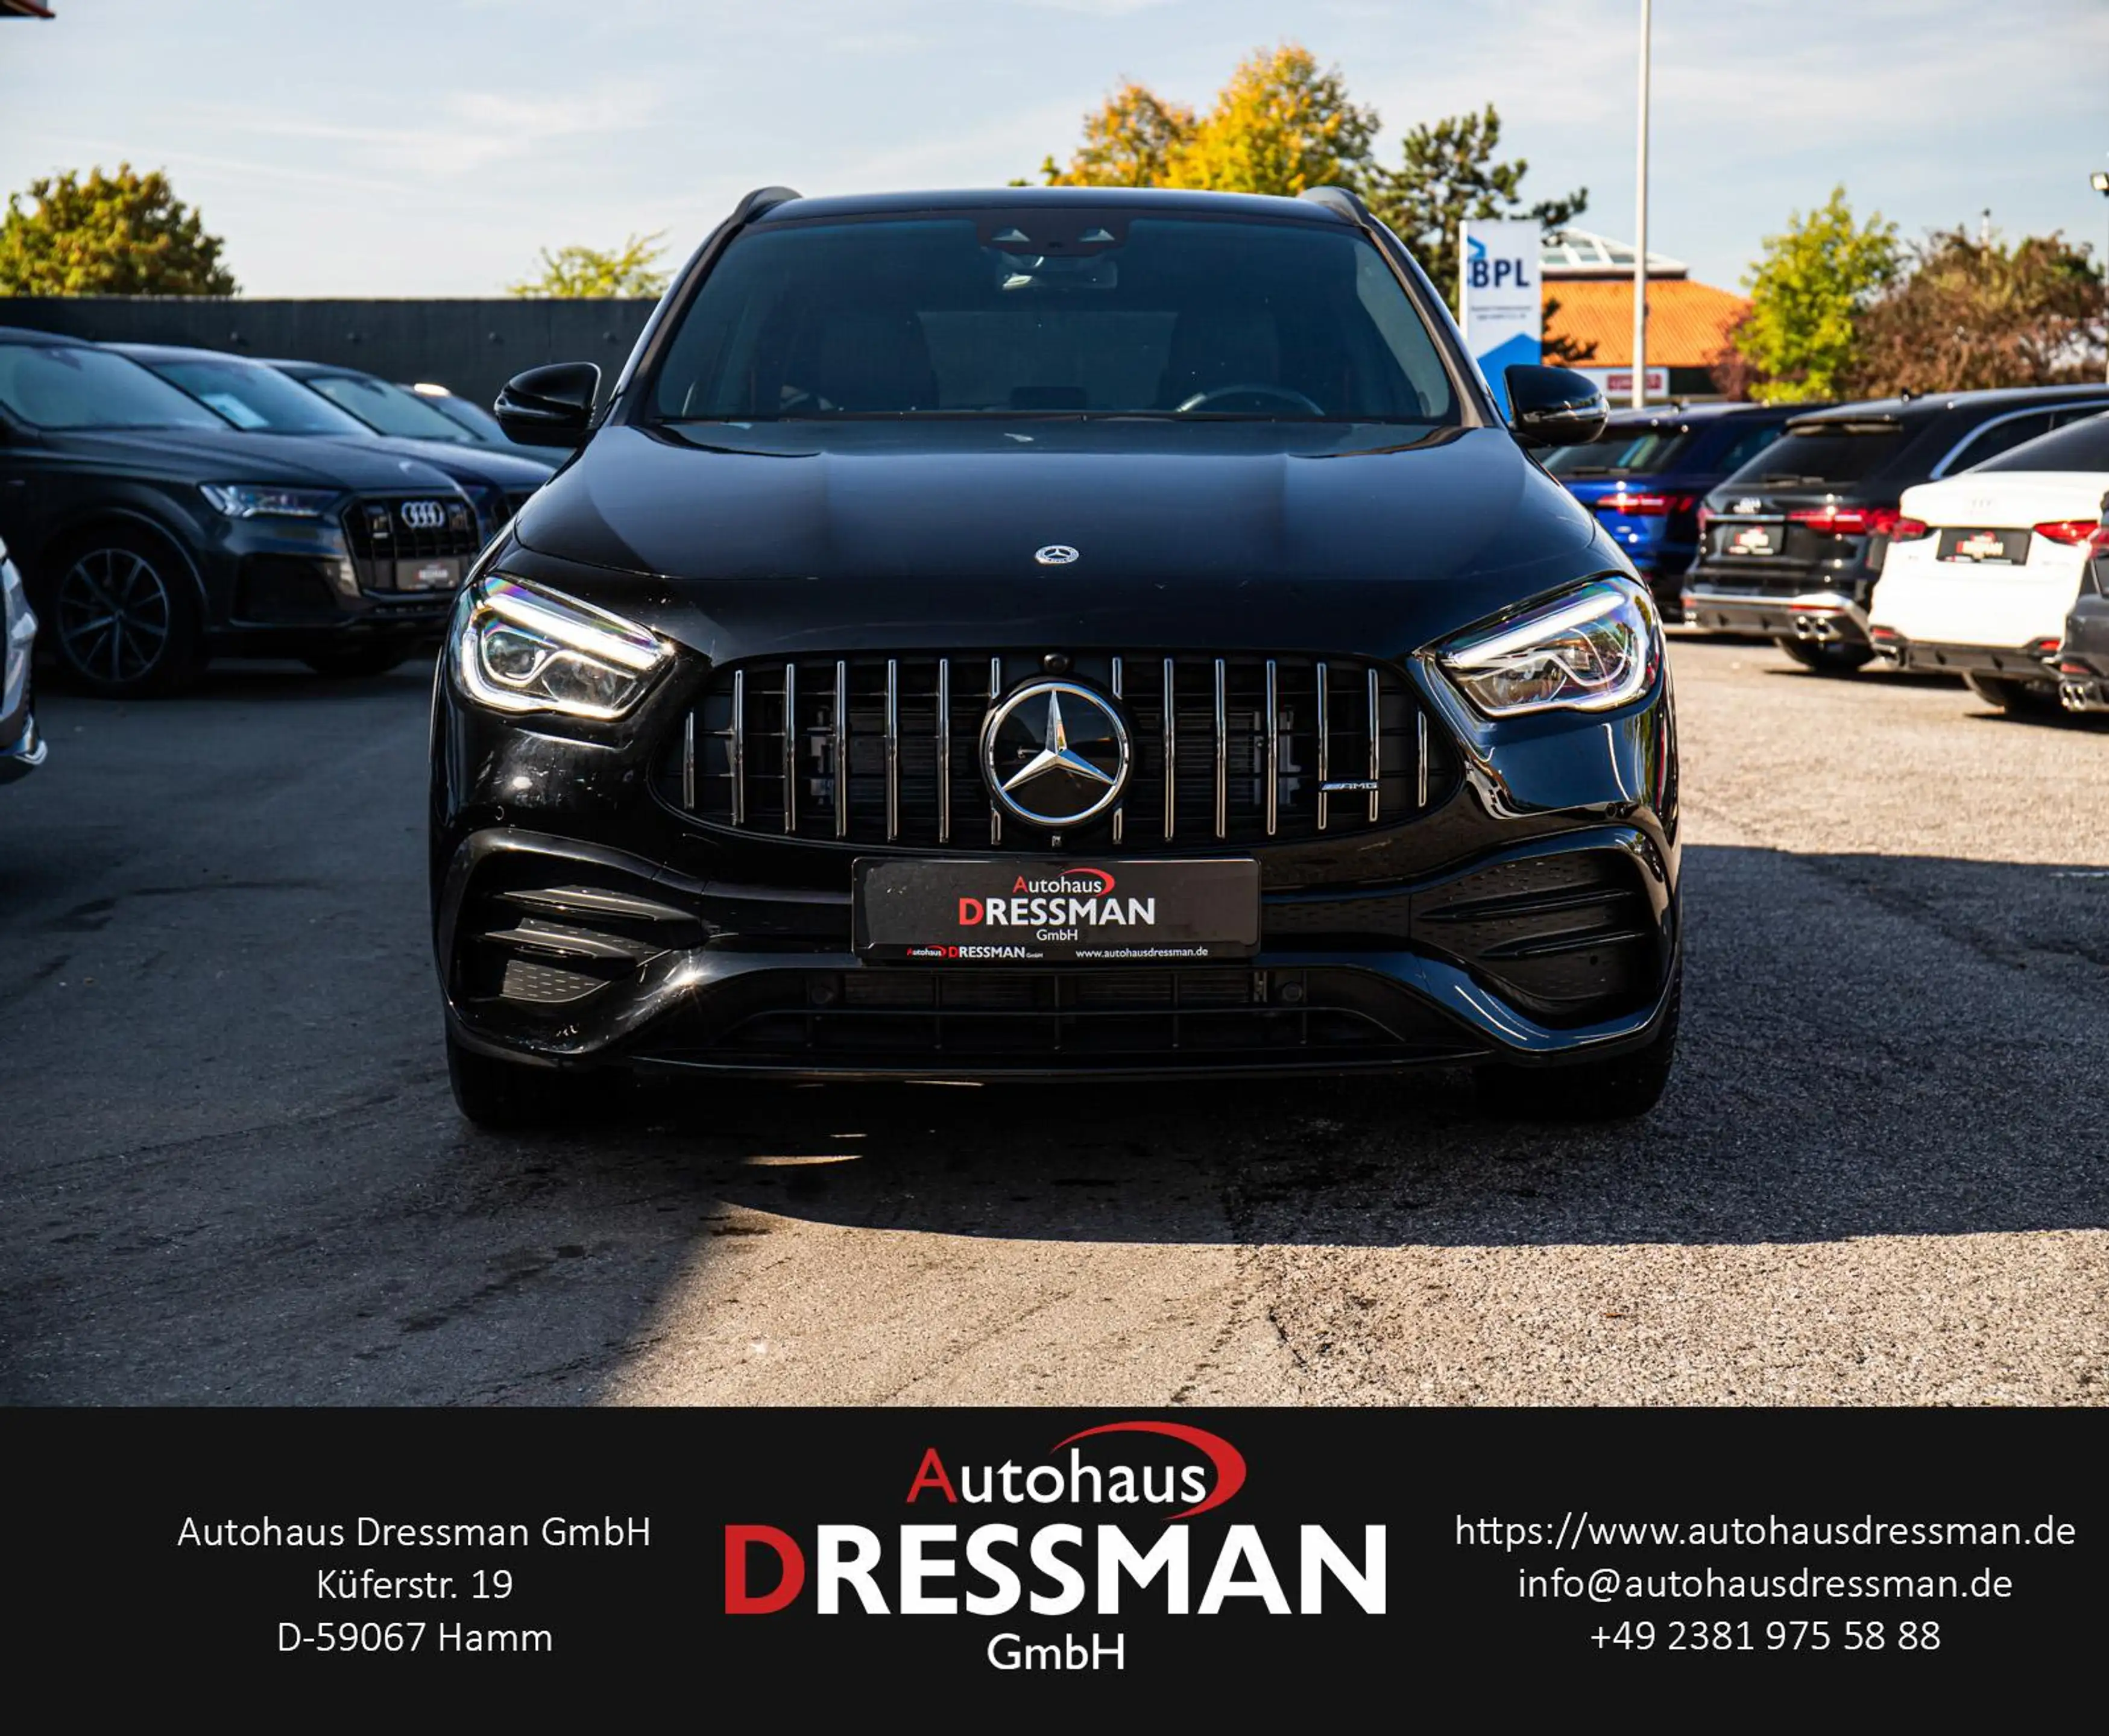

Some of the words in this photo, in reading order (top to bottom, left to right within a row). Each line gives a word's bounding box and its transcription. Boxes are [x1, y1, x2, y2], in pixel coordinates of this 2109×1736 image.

[1472, 259, 1530, 288] BPL
[1340, 782, 1378, 790] AMG
[1012, 875, 1103, 893] Autohaus
[959, 898, 1155, 926] DRESSMAN
[1036, 929, 1078, 942] GmbH
[907, 947, 942, 957] Autohaus
[948, 946, 1025, 958] DRESSMAN
[1076, 945, 1209, 958] www.autohausdressman.de
